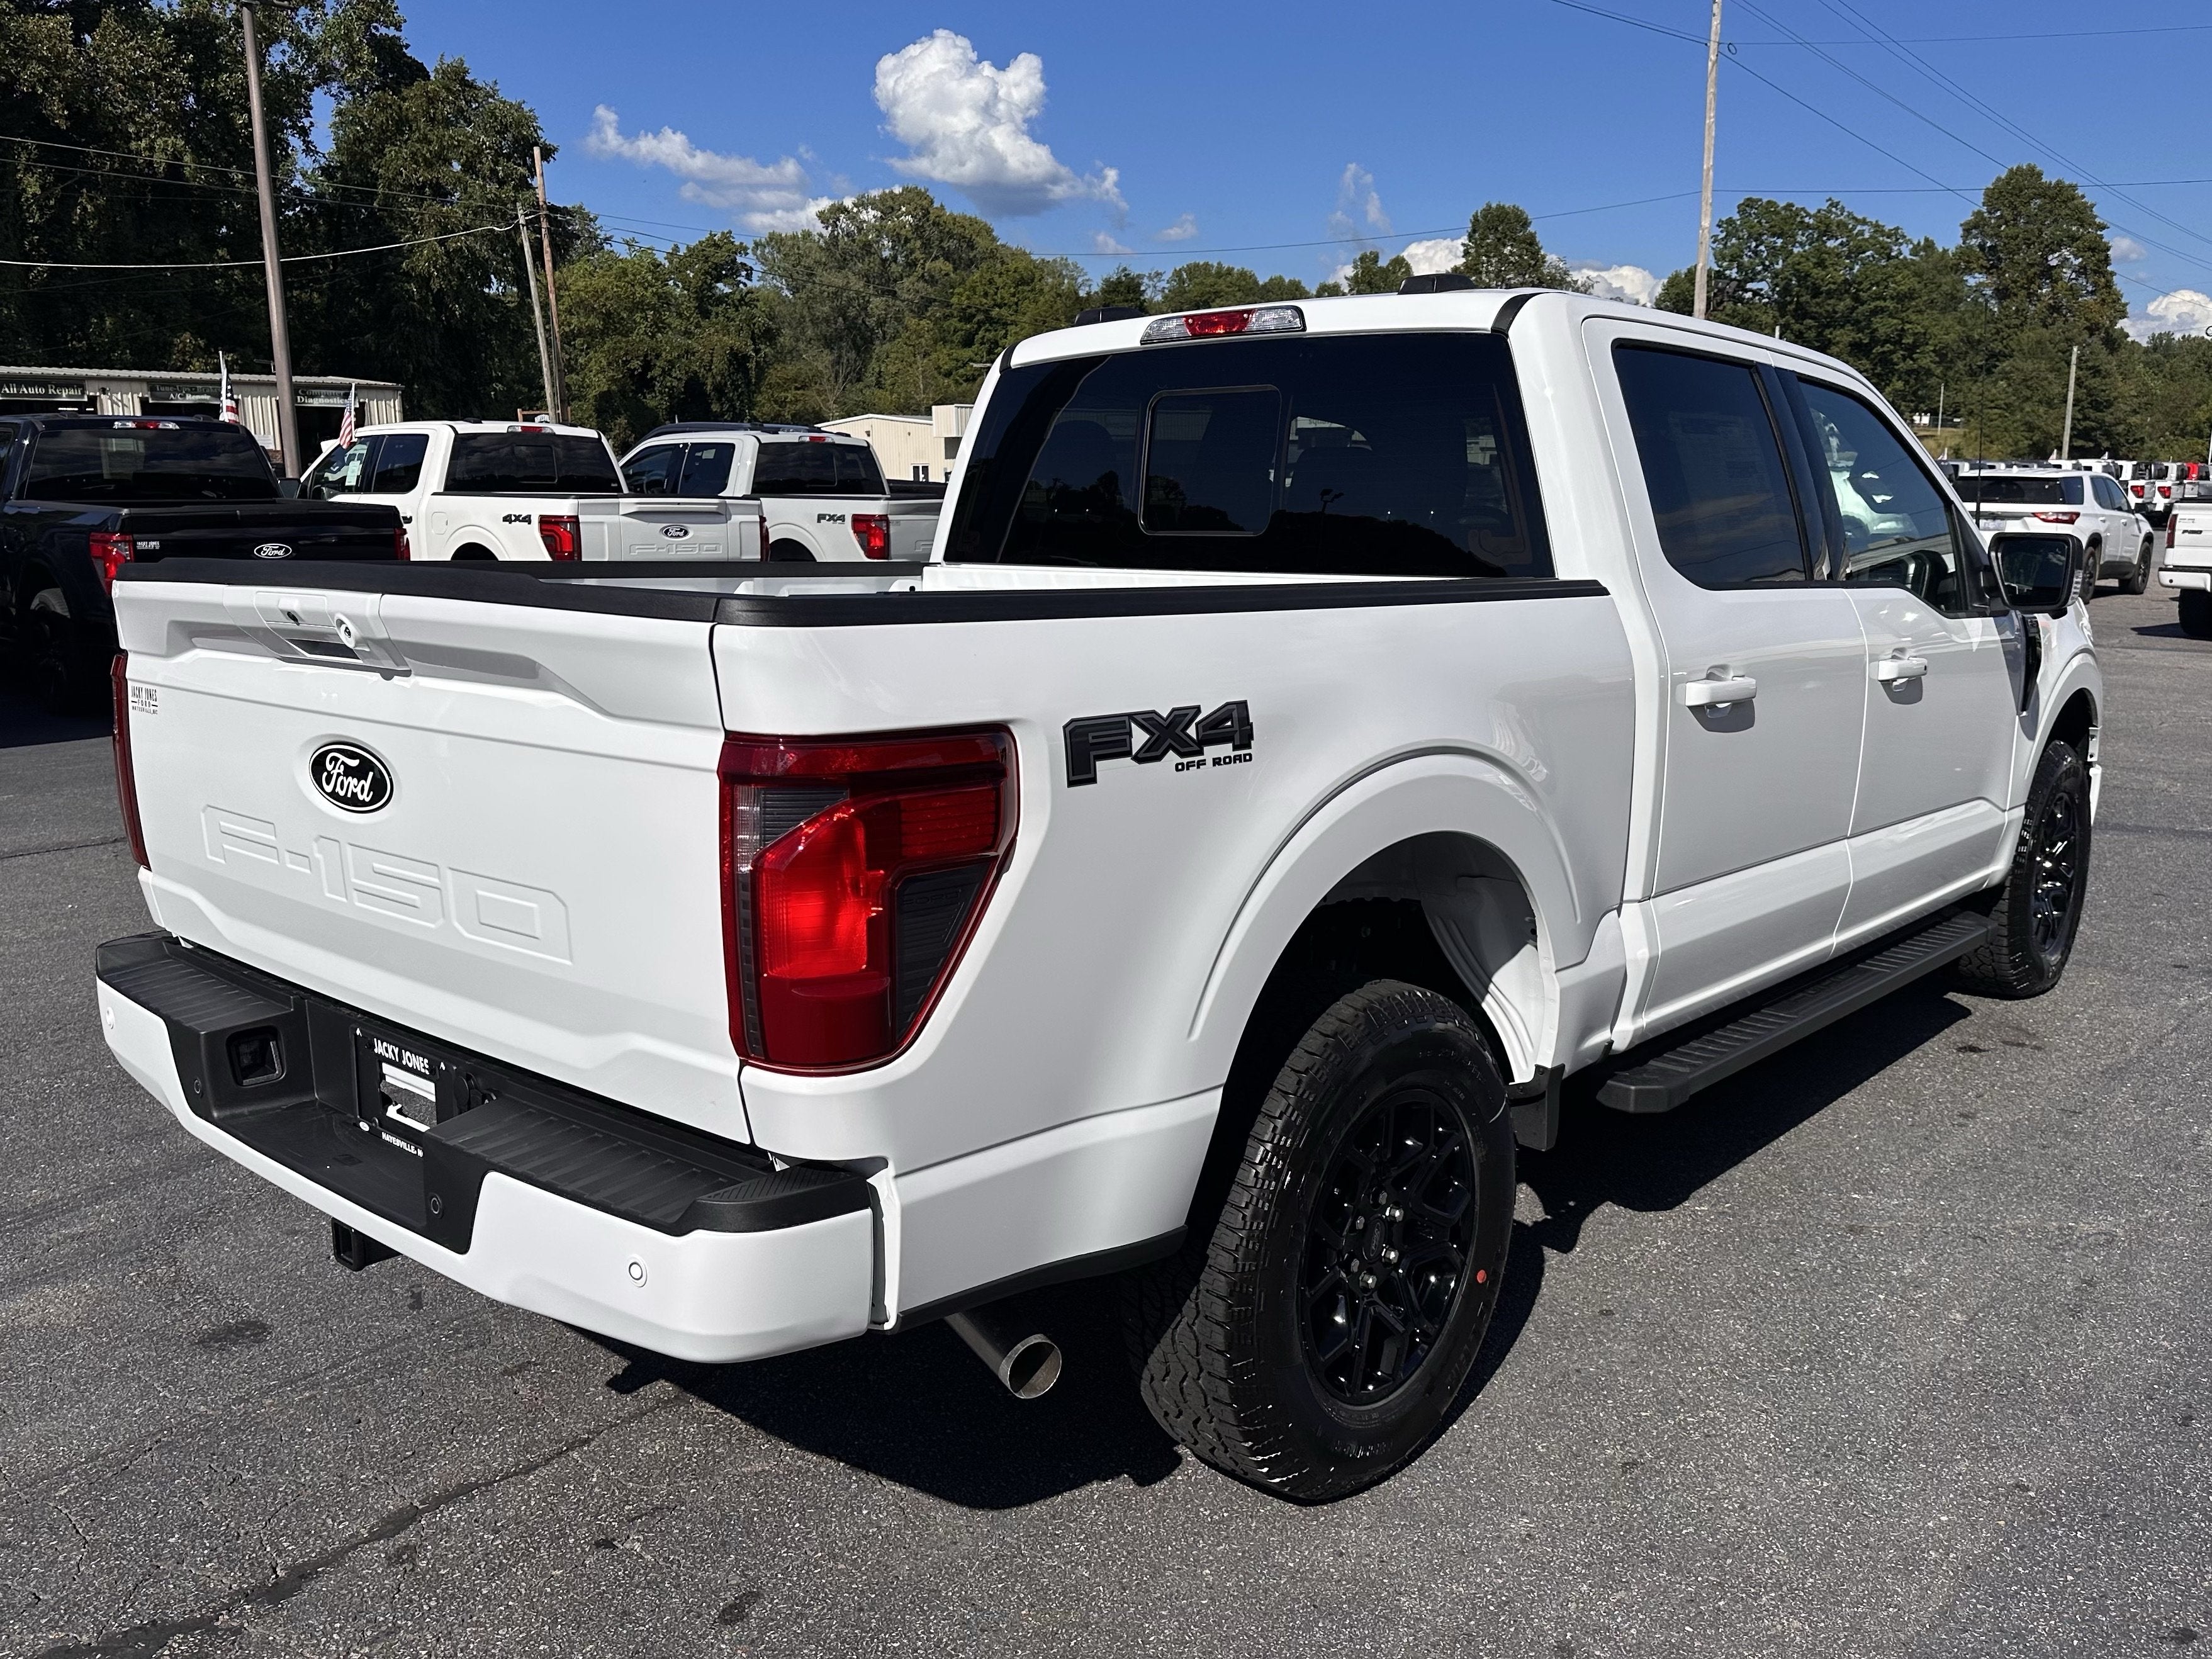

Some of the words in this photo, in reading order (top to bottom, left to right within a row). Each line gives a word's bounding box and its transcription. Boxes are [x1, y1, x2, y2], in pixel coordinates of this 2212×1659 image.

[1, 383, 16, 394] All
[20, 384, 45, 395] Auto
[48, 384, 82, 398] Repair
[817, 513, 845, 523] FX4
[667, 527, 685, 537] Ford
[261, 546, 286, 556] Ford
[629, 543, 722, 555] F-150
[1062, 699, 1254, 788] FX4
[1174, 758, 1206, 773] OFF
[1212, 752, 1253, 767] ROAD
[321, 751, 374, 803] Ford
[200, 804, 574, 965] F-150
[374, 1038, 399, 1062] JACKY
[401, 1049, 430, 1075] JONES
[417, 1149, 424, 1157] N
